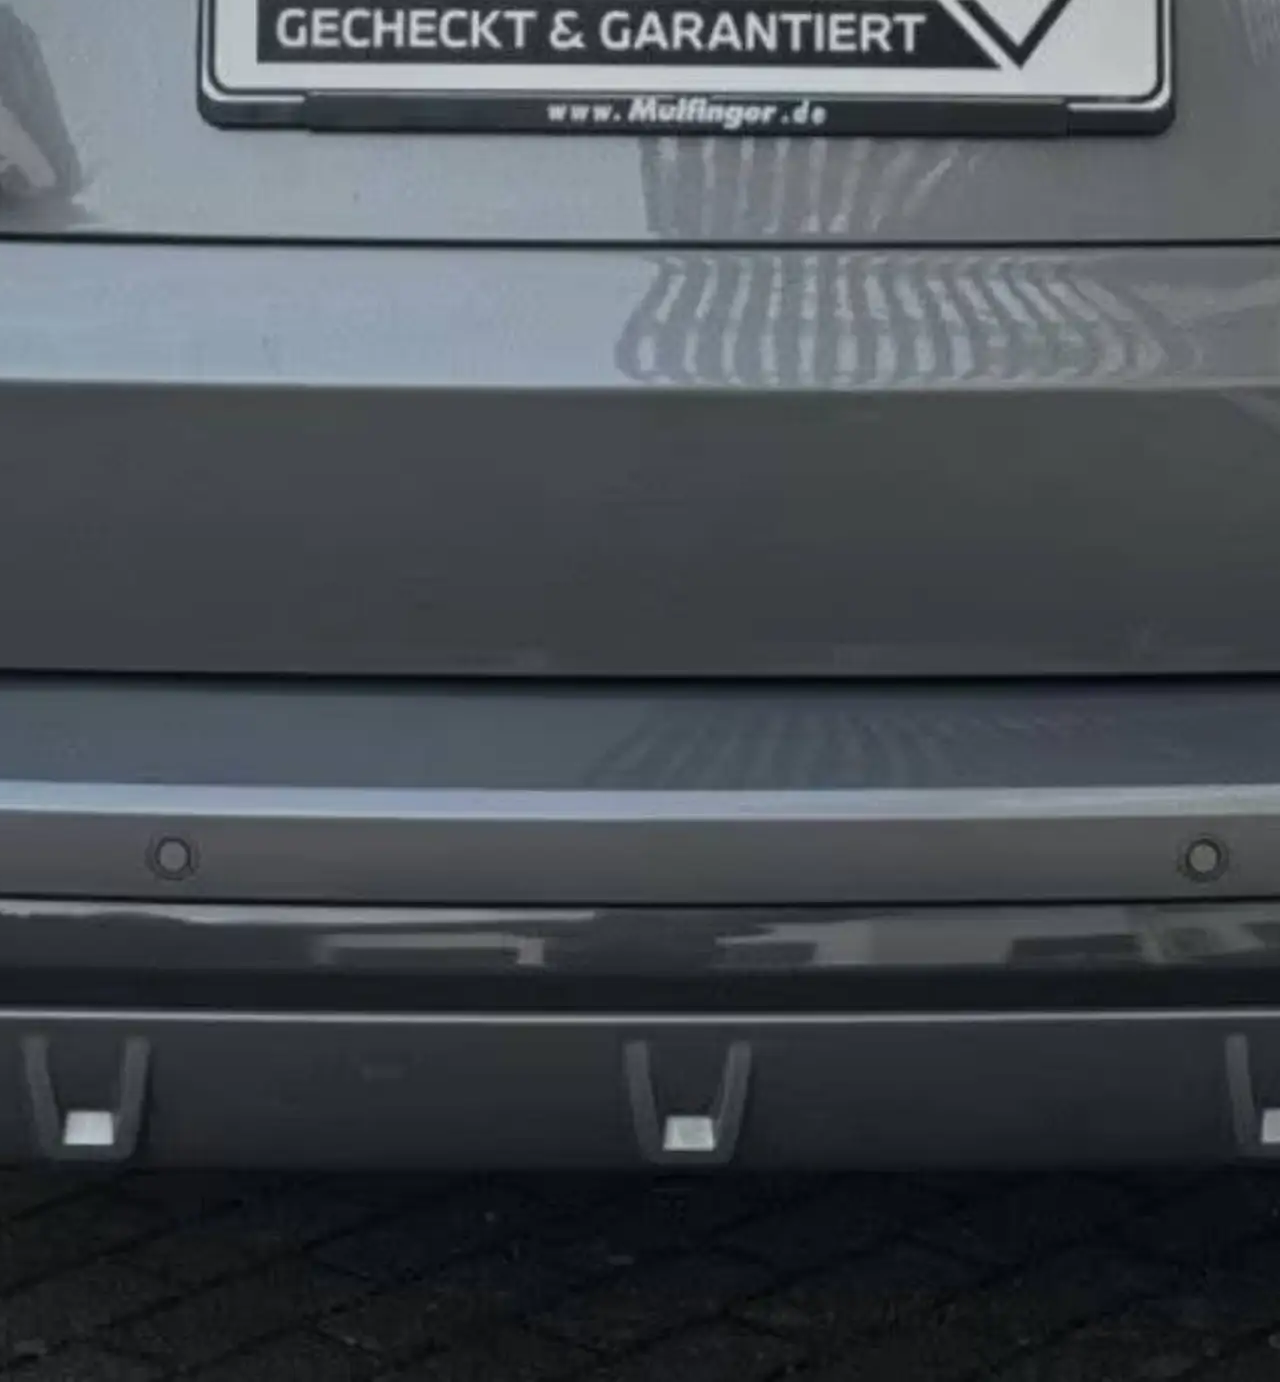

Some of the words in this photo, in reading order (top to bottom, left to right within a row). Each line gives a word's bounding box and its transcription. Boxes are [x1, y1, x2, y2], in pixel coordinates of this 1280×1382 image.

[275, 7, 538, 50] GECHECKT
[548, 10, 587, 50] &
[599, 10, 928, 54] GARANTIERT
